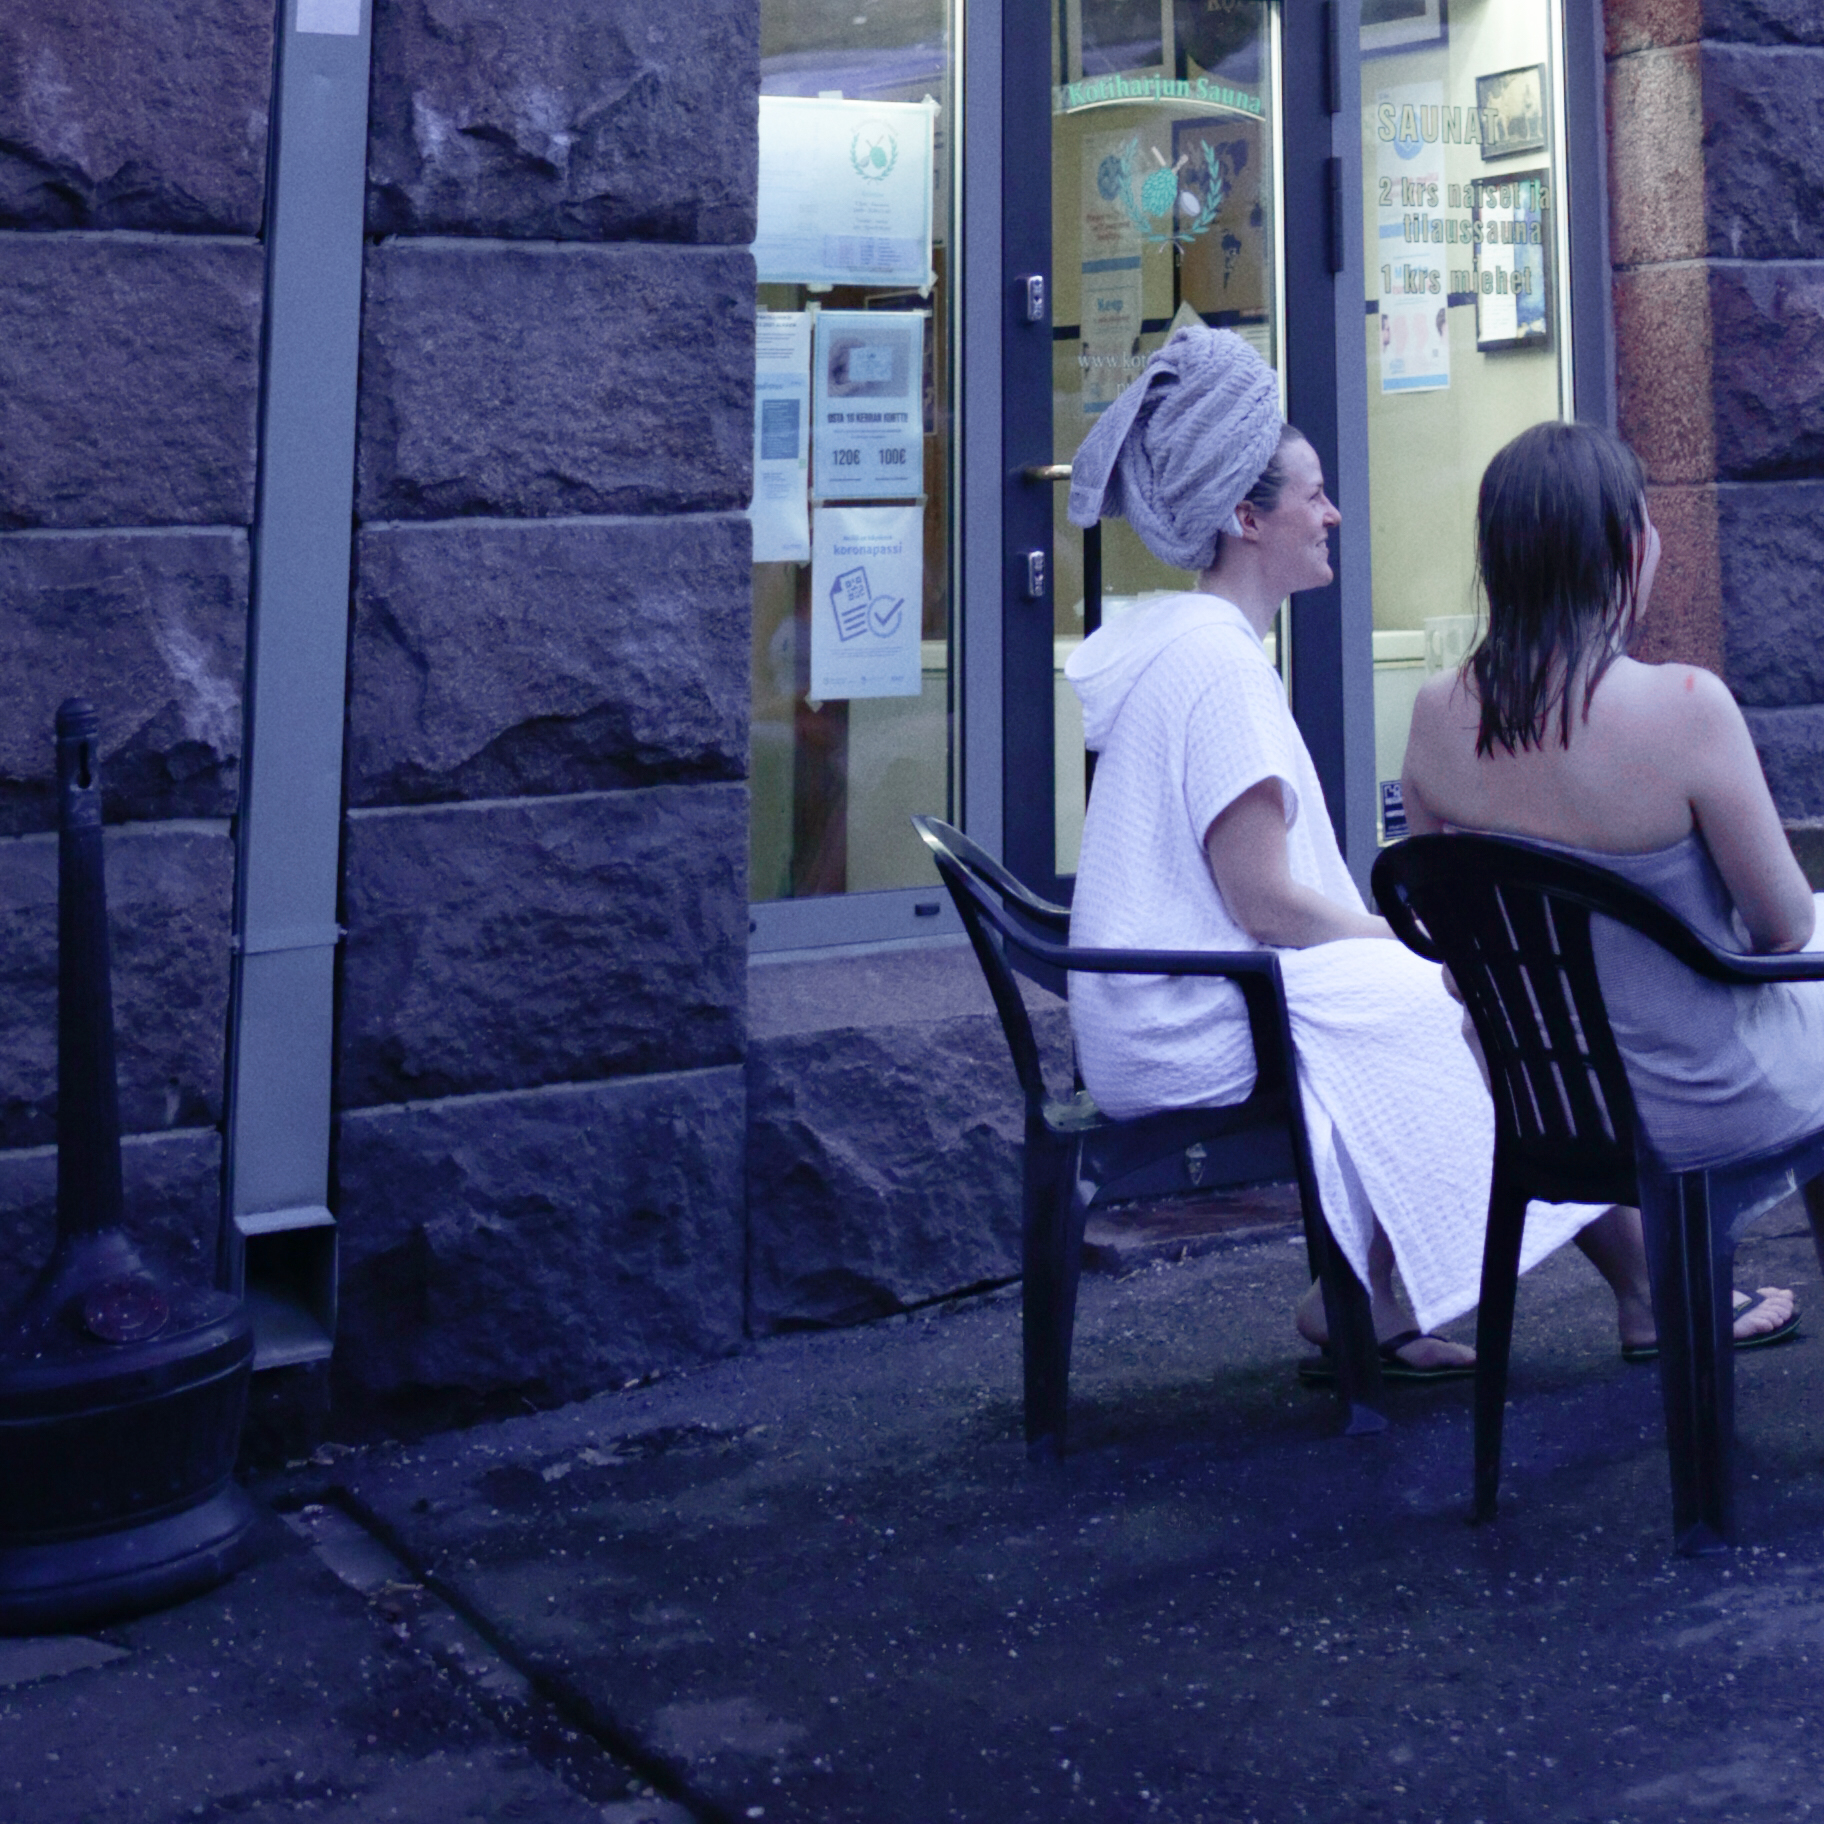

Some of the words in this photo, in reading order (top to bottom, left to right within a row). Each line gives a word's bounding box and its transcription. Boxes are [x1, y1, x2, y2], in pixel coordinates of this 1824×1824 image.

[1068, 73, 1190, 107] Kotiharjun
[1197, 76, 1261, 114] Sauna
[1377, 102, 1499, 145] SAUNAT
[1378, 176, 1393, 207] 2
[1401, 177, 1439, 208] krs
[1448, 179, 1521, 209] naiset
[1530, 181, 1550, 212] ja
[1403, 213, 1543, 244] tilaussauna
[1381, 264, 1391, 294] 1
[1403, 264, 1441, 294] krs
[1450, 257, 1533, 295] miehet
[833, 449, 860, 465] 120€
[879, 448, 906, 464] 100€
[833, 541, 903, 557] koronapassi
